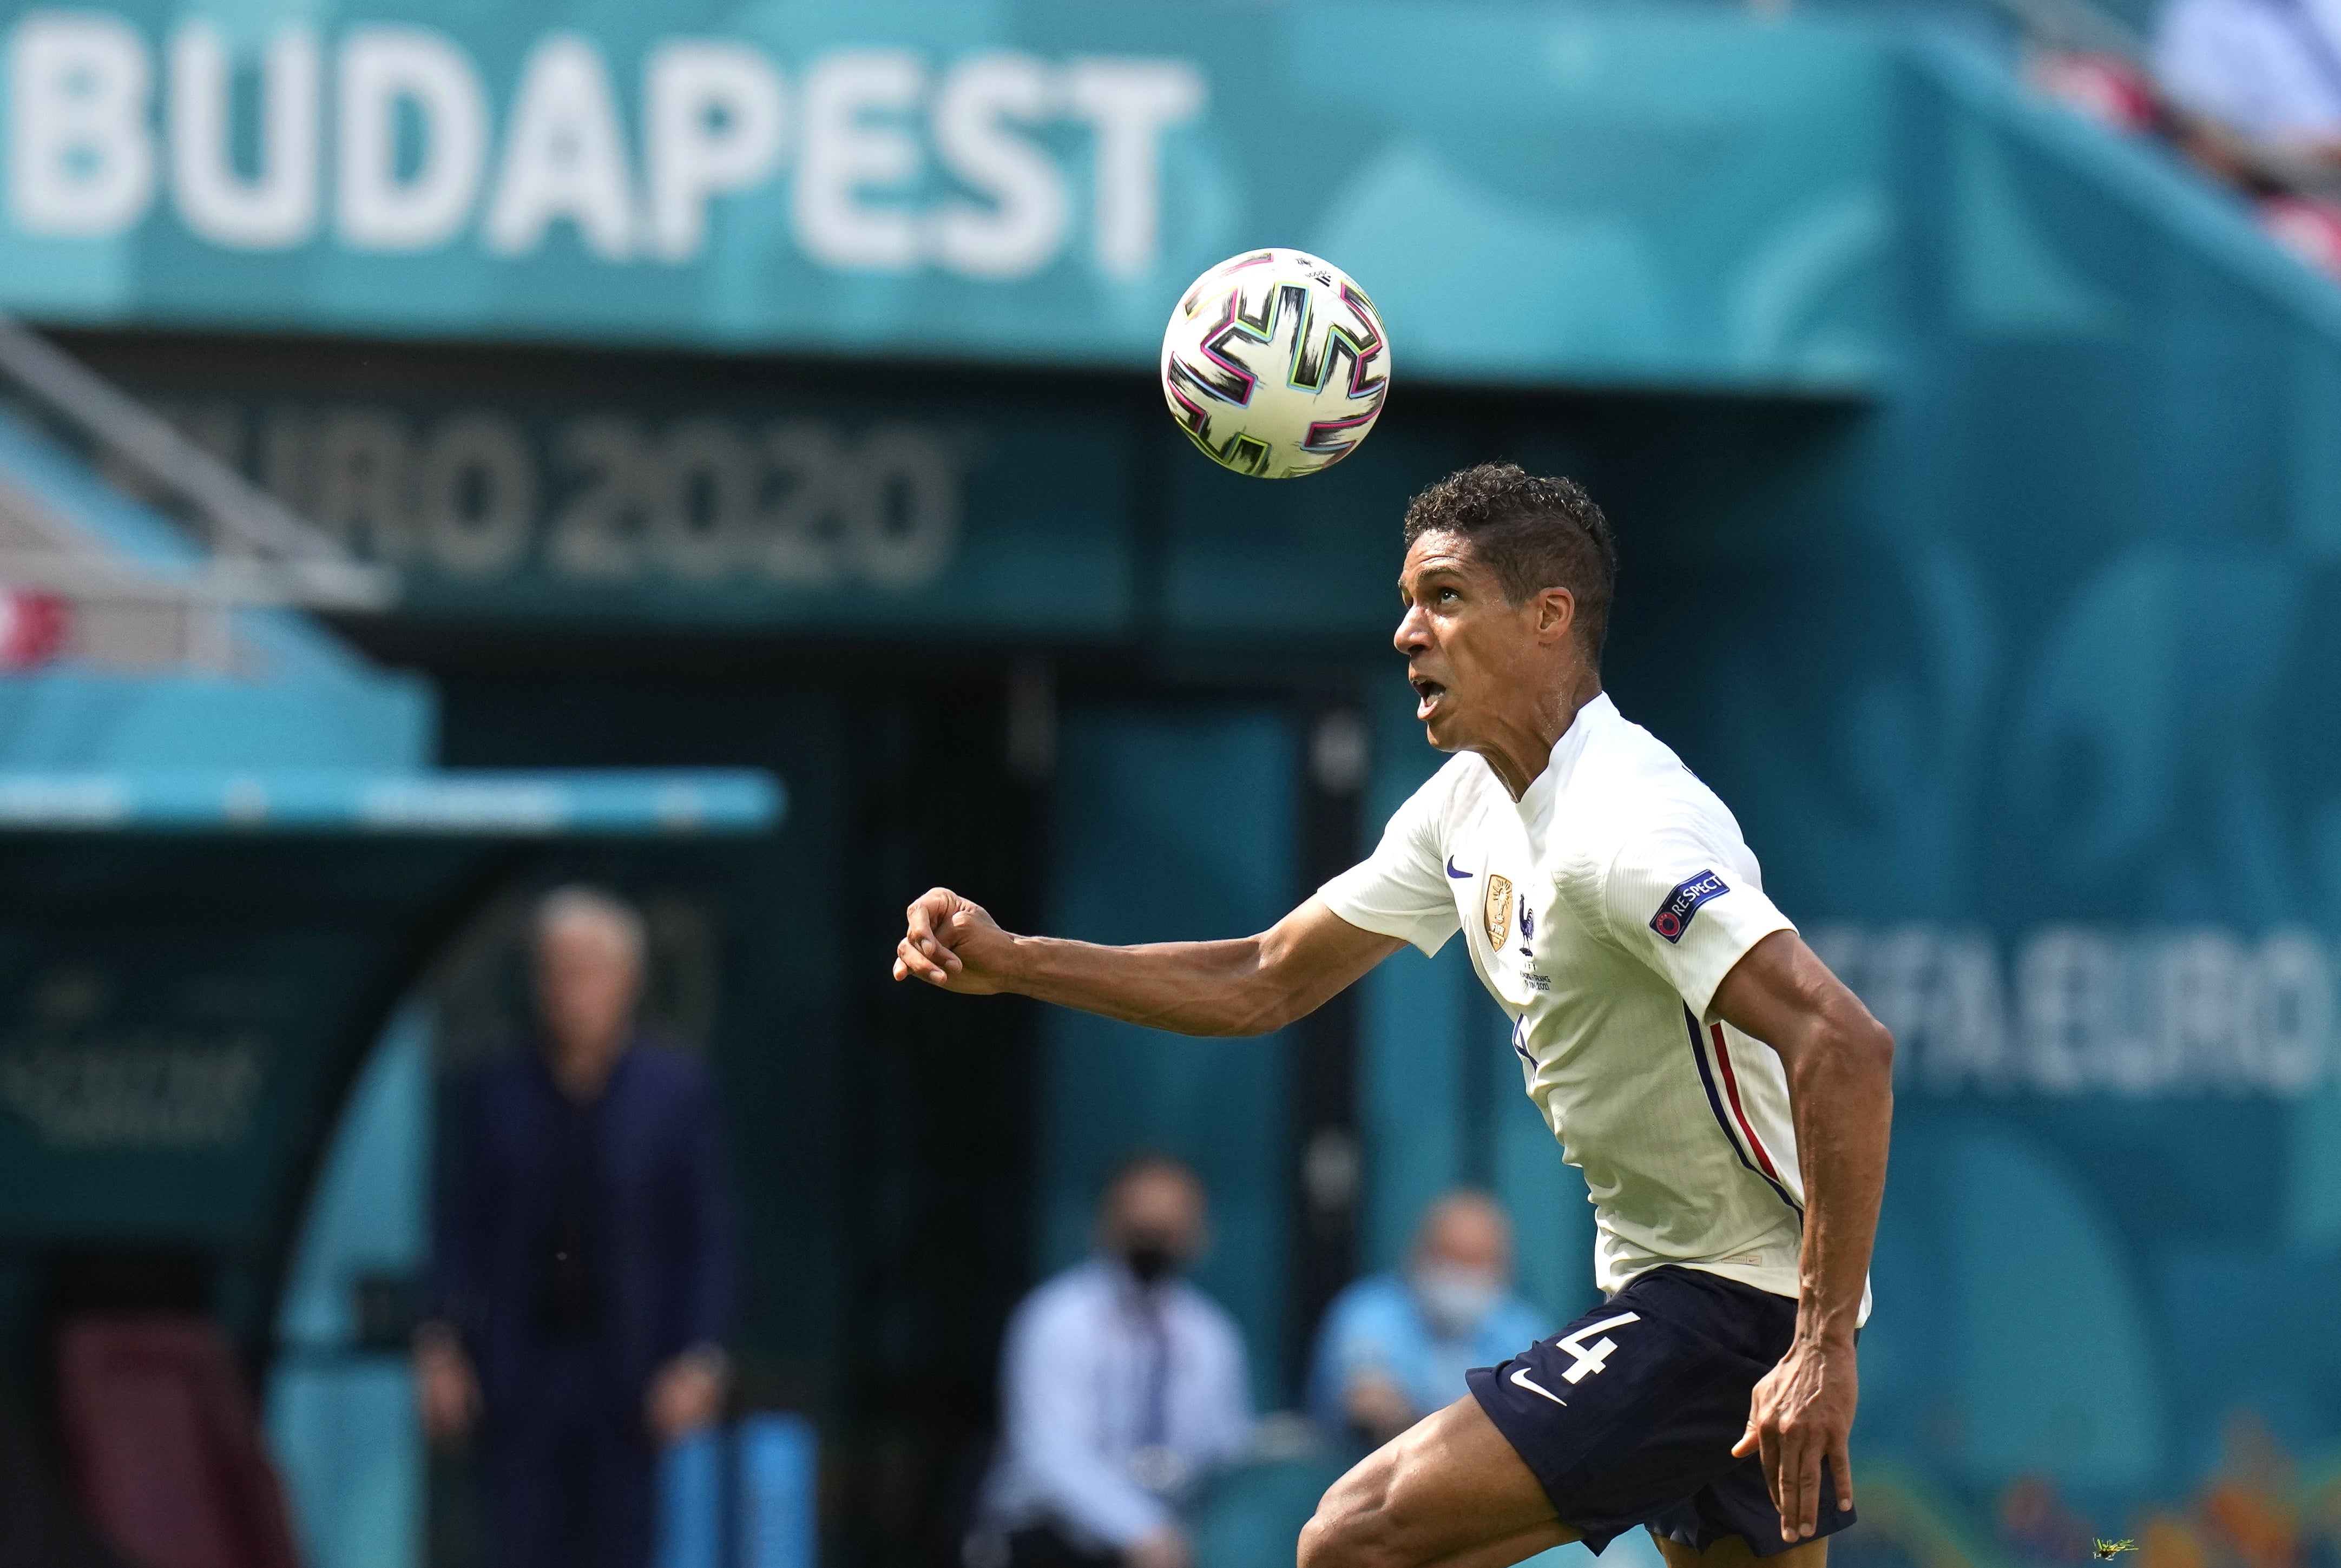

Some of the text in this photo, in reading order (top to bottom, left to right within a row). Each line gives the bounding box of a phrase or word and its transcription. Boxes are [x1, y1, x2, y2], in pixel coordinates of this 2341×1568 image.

[5, 11, 1204, 279] BUDAPEST
[547, 417, 963, 590] 2020
[1672, 875, 1721, 917] RESPECT
[2017, 924, 2333, 1095] EURO
[1556, 1312, 1641, 1384] 4
